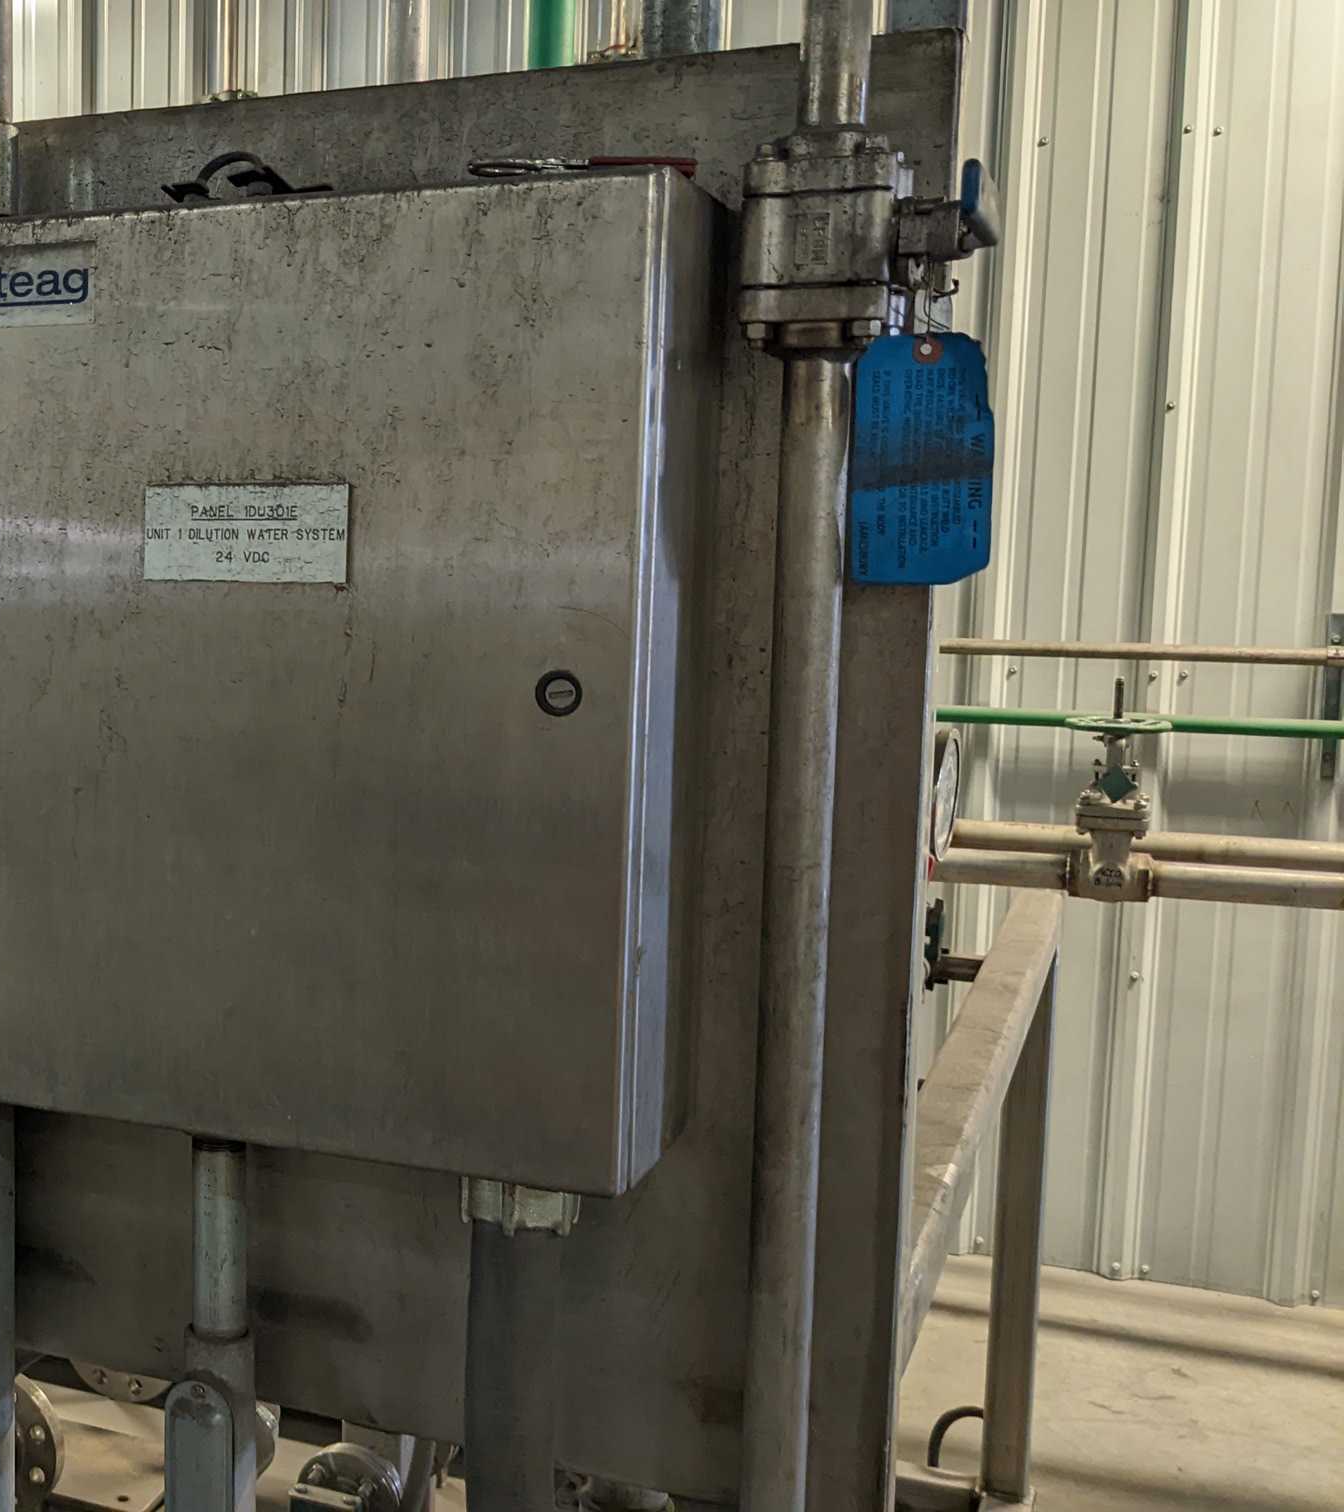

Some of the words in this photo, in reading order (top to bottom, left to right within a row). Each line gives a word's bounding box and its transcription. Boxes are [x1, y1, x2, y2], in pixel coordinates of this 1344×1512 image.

[191, 505, 234, 518] PANEL
[146, 528, 172, 540] UNIT
[188, 528, 239, 541] DILUTION
[247, 528, 289, 541] WATER
[296, 528, 345, 541] SYSTEM
[215, 551, 232, 563] 24
[243, 551, 270, 563] VDC
